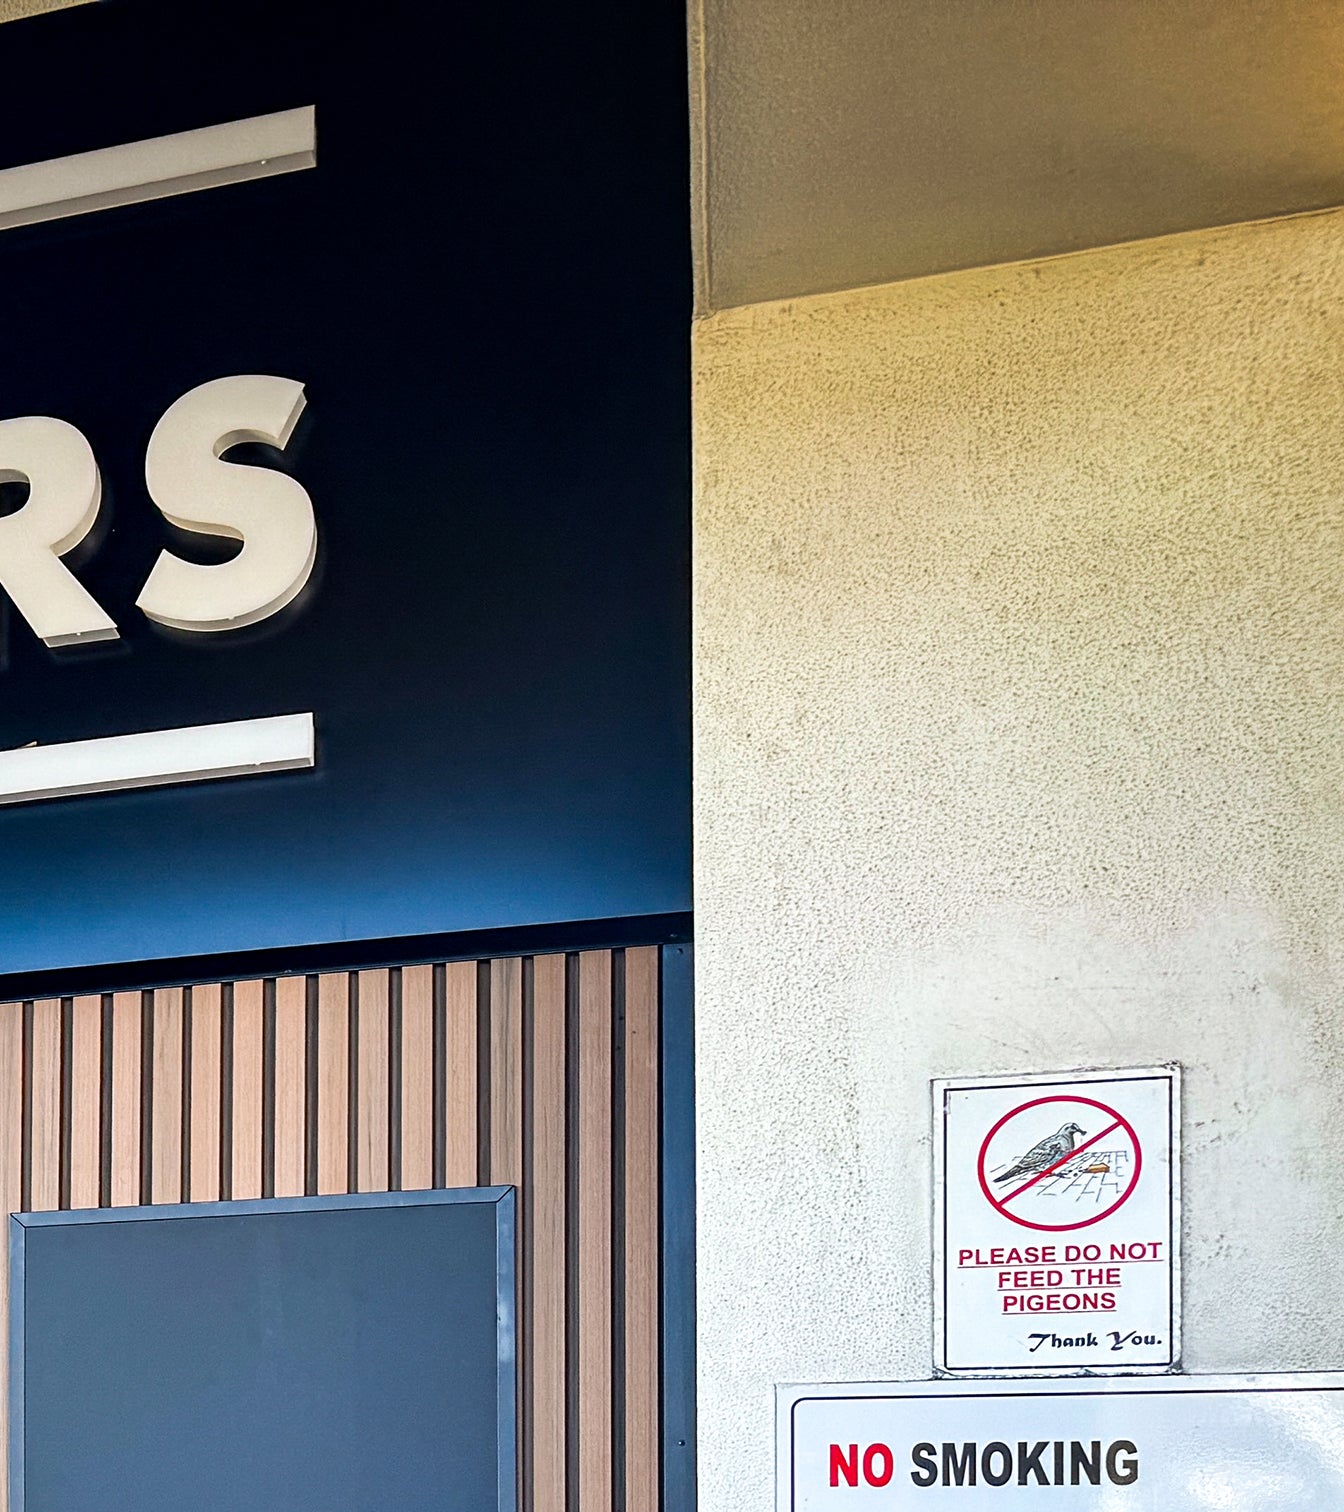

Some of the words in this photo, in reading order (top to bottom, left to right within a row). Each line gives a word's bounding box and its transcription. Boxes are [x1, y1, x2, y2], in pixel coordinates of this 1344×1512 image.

[958, 1245, 1056, 1267] PLEASE
[1064, 1244, 1103, 1265] DO
[1111, 1241, 1163, 1262] NOT
[998, 1268, 1064, 1288] FEED
[1072, 1267, 1121, 1286] THE
[1003, 1292, 1117, 1312] PIGEONS
[1029, 1331, 1098, 1353] Thank
[1107, 1329, 1163, 1352] You.
[829, 1444, 894, 1487] NO
[910, 1441, 1140, 1487] SMOKING
